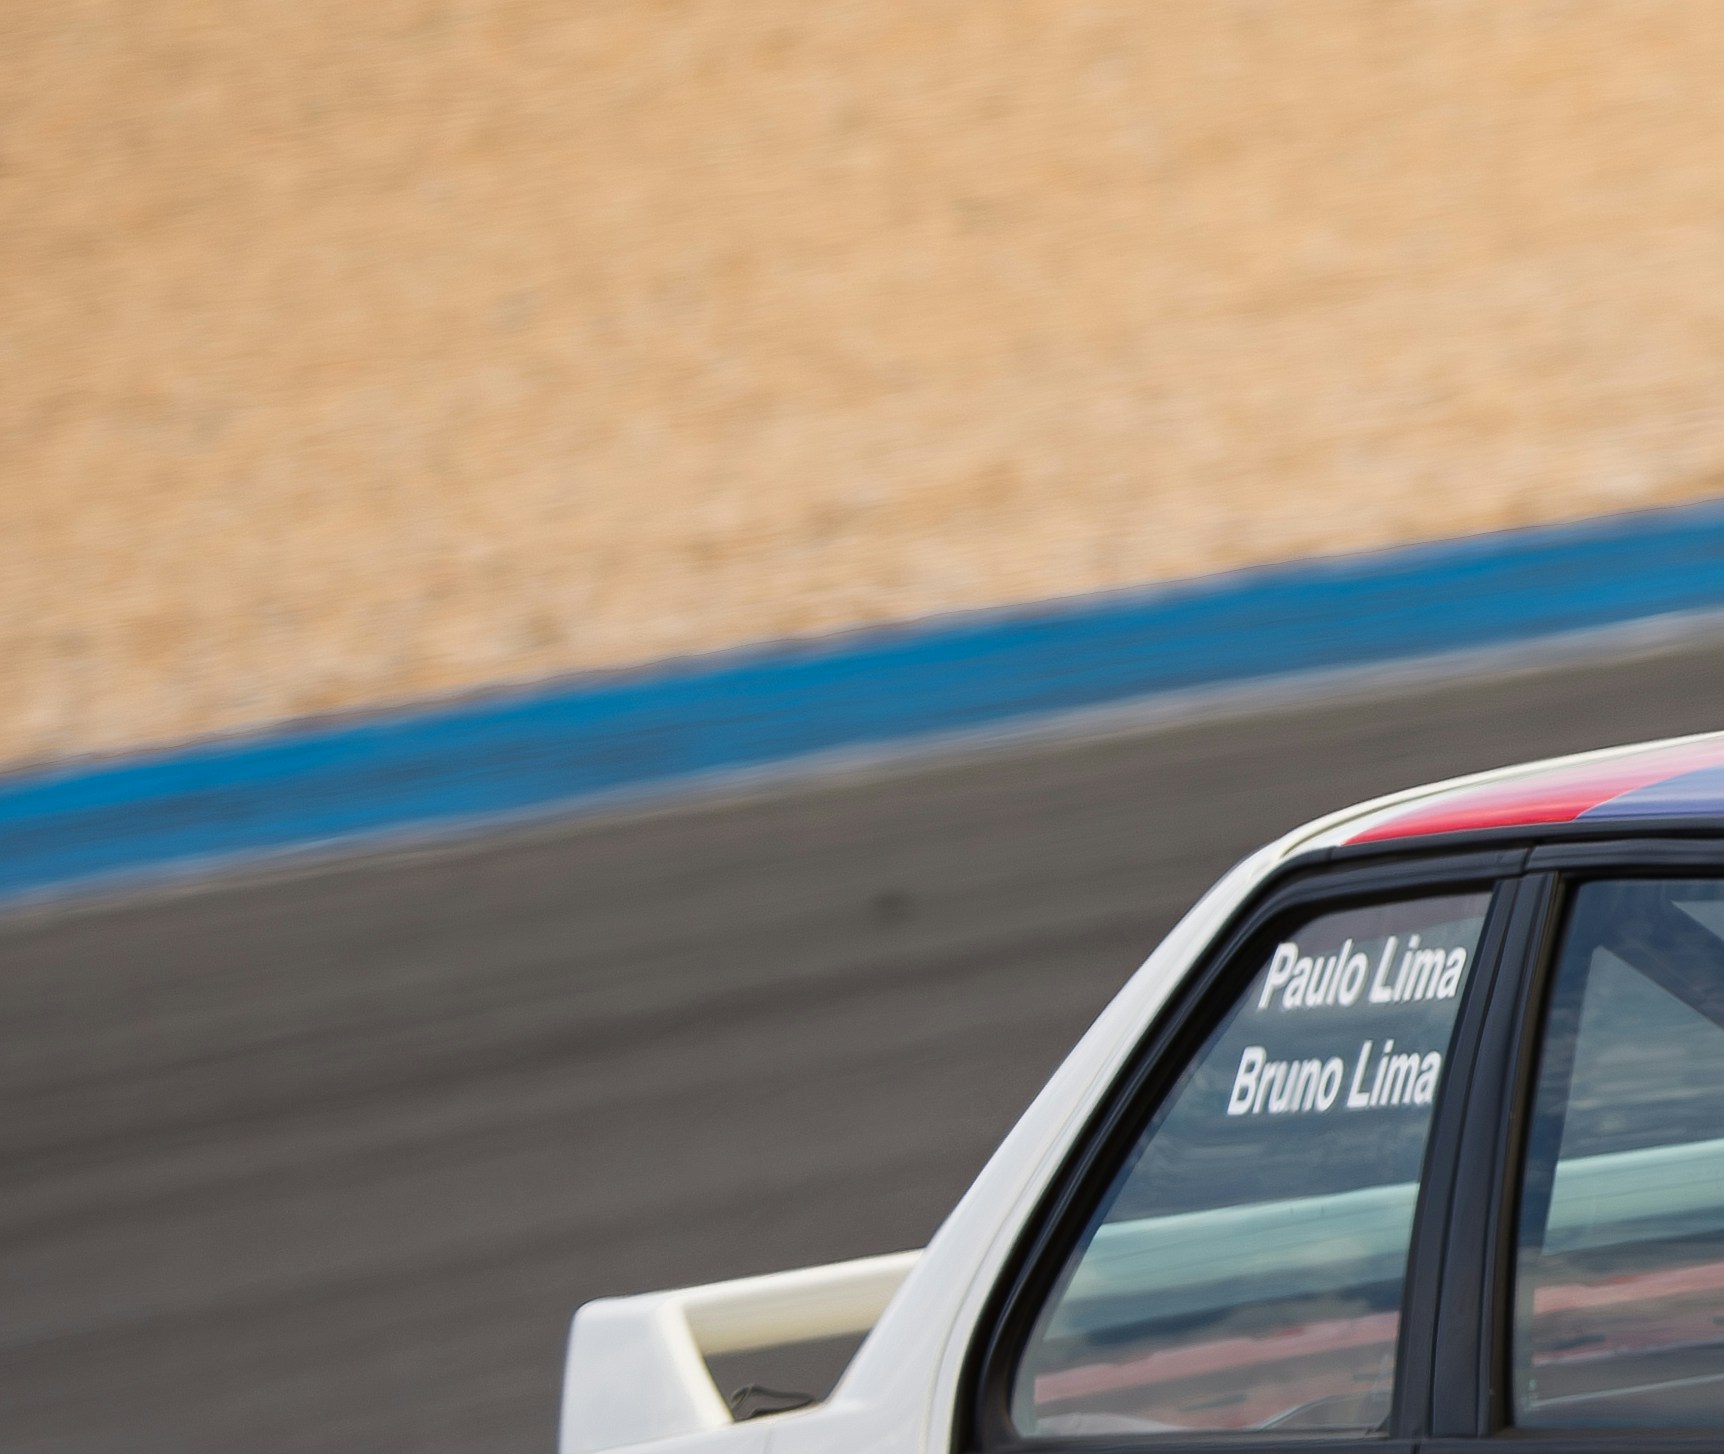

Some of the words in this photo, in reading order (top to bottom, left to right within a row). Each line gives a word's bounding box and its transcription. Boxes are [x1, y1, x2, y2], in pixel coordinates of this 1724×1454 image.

[1257, 937, 1368, 1011] Paulo
[1368, 934, 1467, 1004] Lima
[1227, 1046, 1344, 1116] Bruno
[1347, 1039, 1442, 1108] Lima
